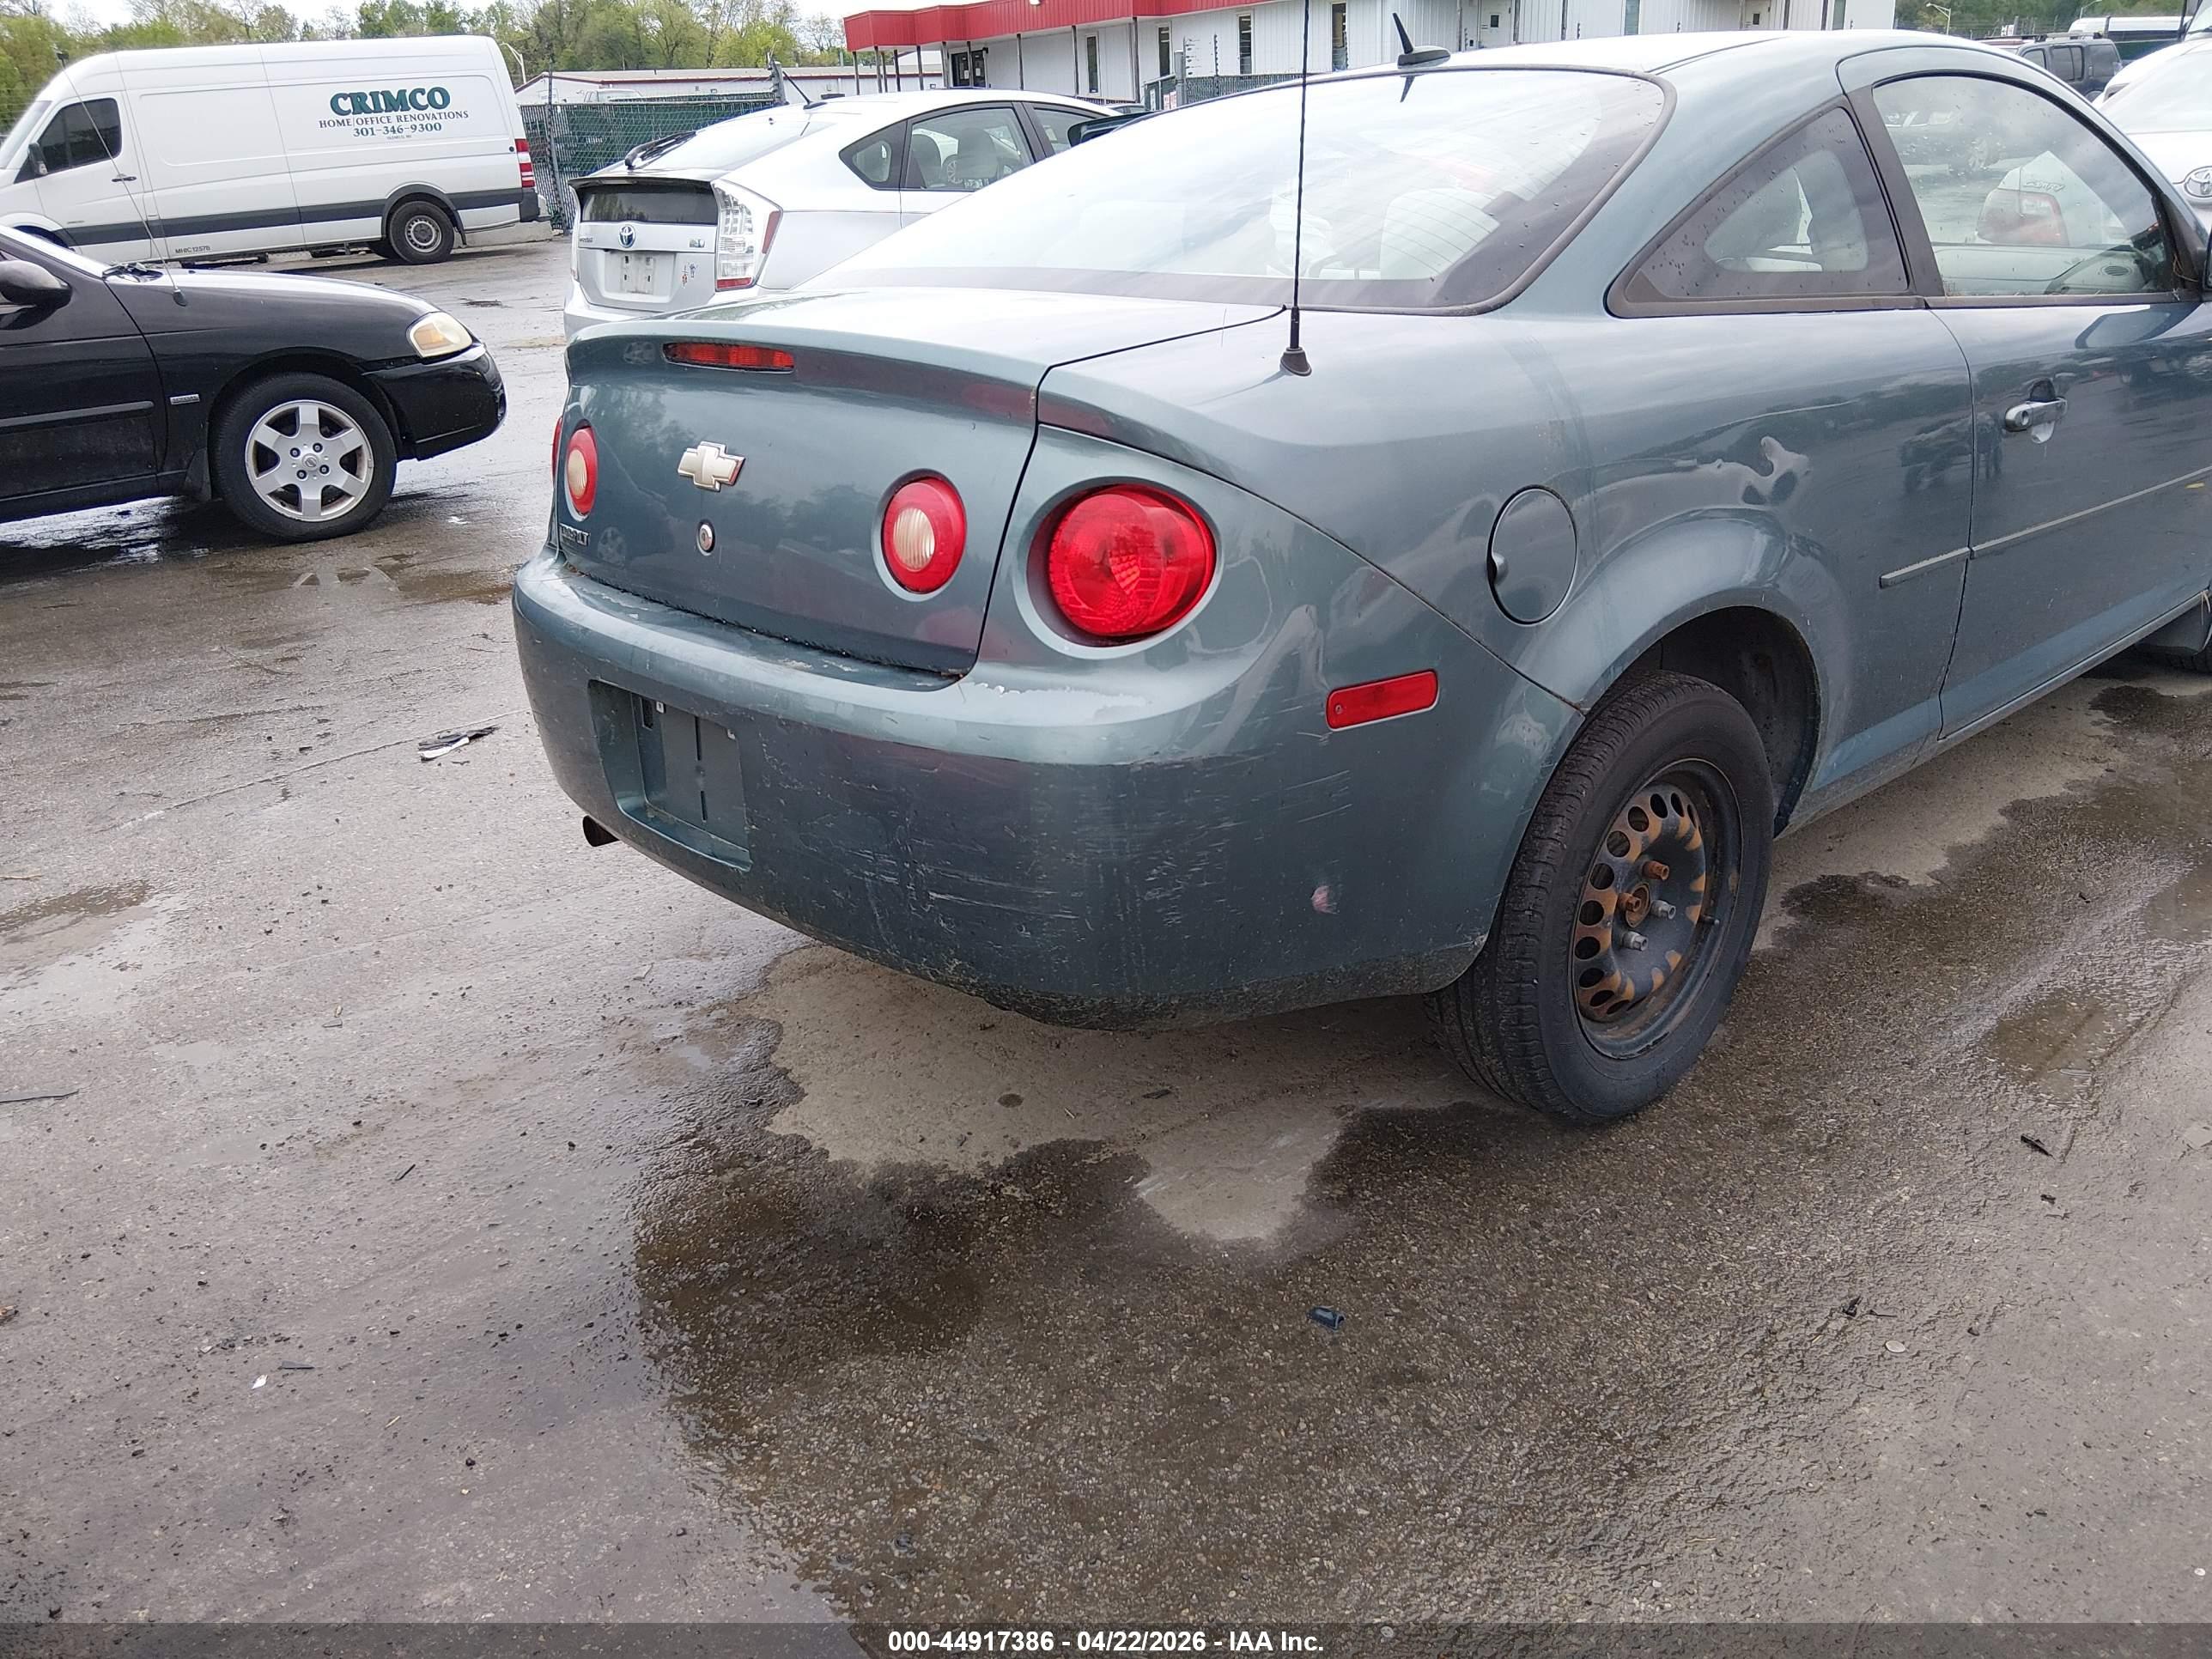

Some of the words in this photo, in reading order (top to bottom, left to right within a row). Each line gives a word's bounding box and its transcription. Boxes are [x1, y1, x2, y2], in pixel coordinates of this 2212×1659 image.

[330, 87, 451, 116] CRIMCO
[396, 110, 469, 123] RENOVATIONS
[353, 122, 442, 137] 301-346-9300
